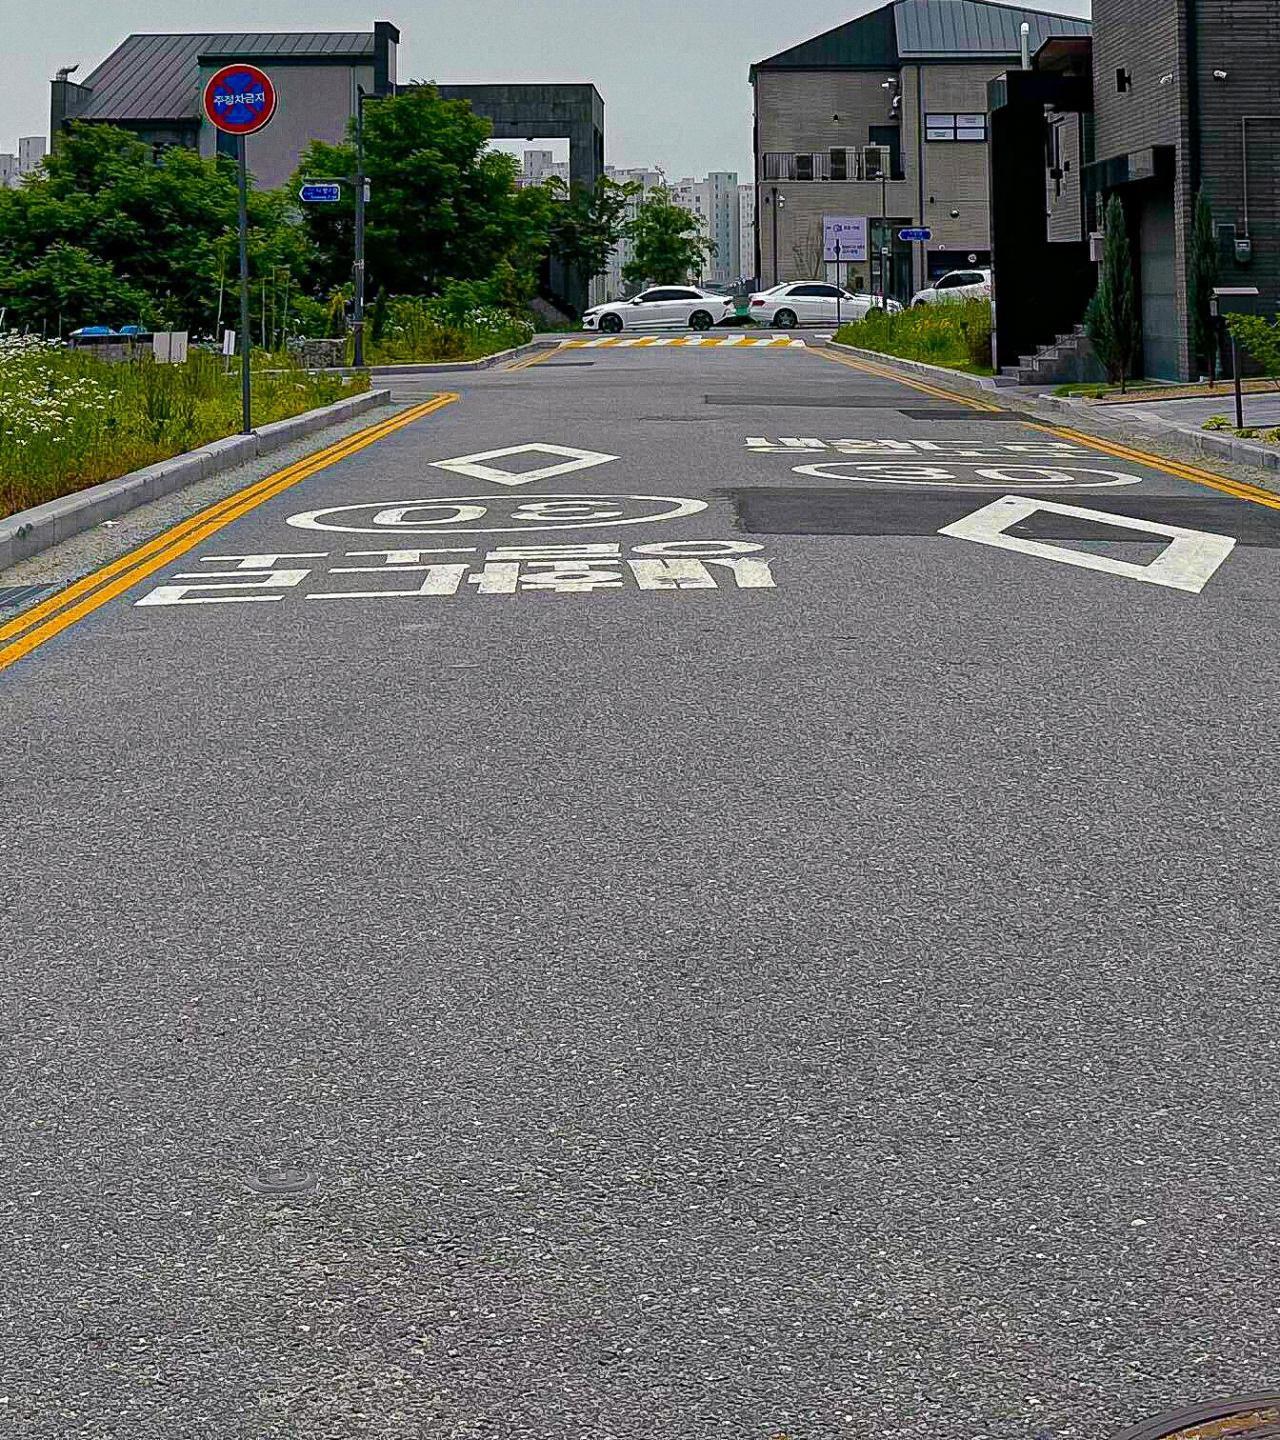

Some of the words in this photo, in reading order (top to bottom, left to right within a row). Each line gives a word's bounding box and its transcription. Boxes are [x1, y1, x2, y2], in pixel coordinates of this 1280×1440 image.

[213, 90, 265, 107] 주정차금지
[744, 436, 1111, 460] 생활도로
[856, 465, 1074, 482] 30
[372, 500, 623, 526] 30
[133, 540, 777, 607] 생활도로
